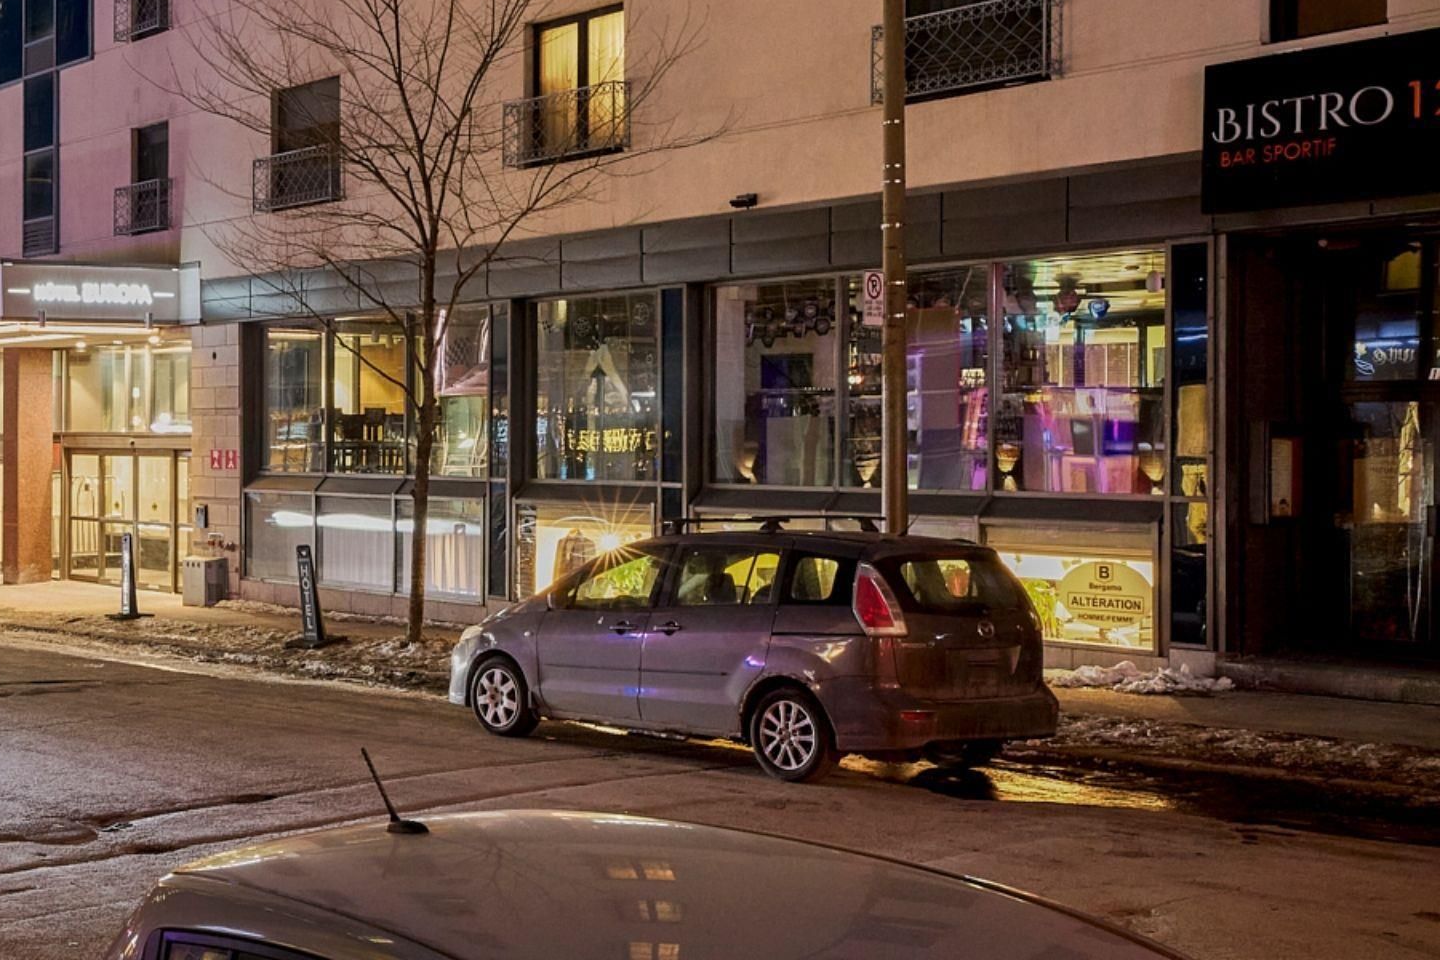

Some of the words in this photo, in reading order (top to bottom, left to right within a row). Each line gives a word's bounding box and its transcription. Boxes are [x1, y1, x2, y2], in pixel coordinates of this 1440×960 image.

[1212, 86, 1394, 144] BISTRO
[1220, 148, 1256, 168] BAR
[1263, 137, 1336, 164] SPORTIF
[1099, 566, 1110, 579] B
[300, 565, 314, 630] HOTEL
